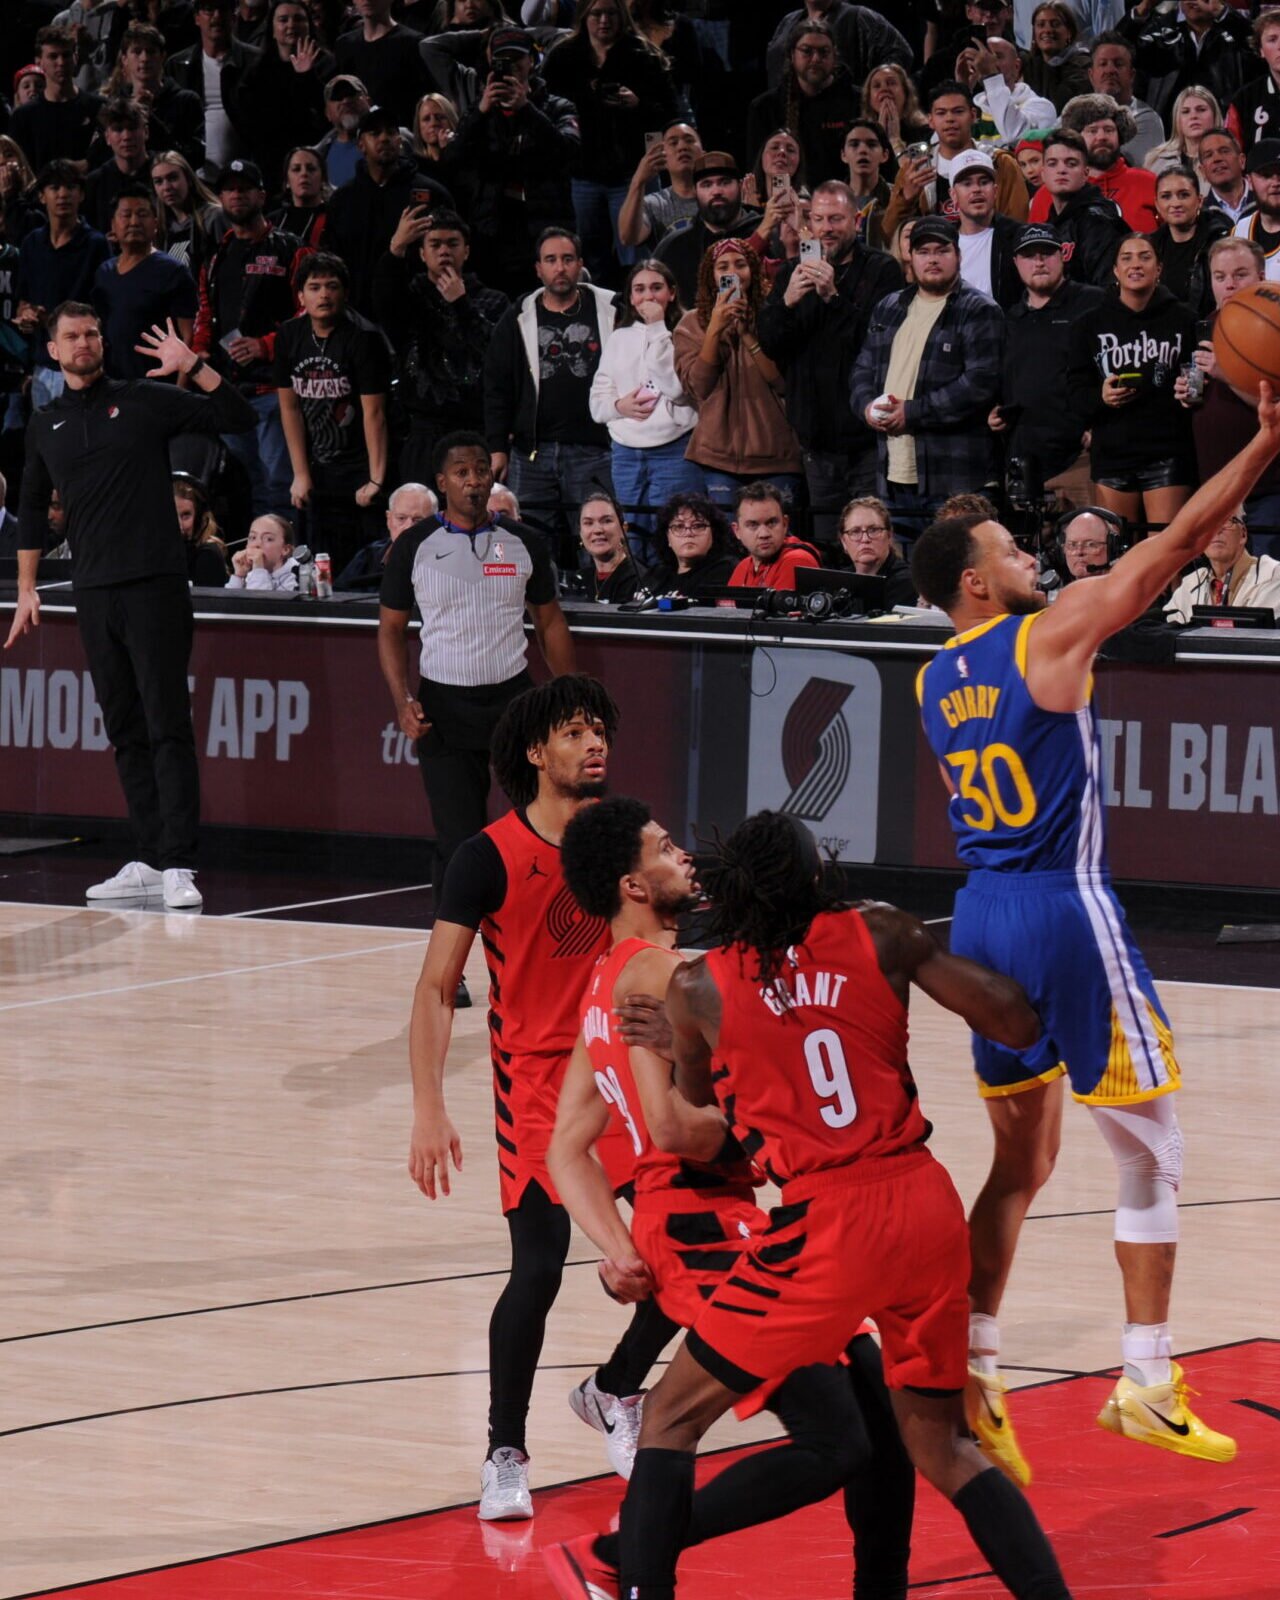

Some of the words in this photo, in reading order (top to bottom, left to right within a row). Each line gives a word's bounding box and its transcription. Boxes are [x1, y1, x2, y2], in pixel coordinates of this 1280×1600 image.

[1097, 330, 1183, 377] Portland
[483, 565, 516, 575] Emirates
[206, 677, 310, 761] APP
[939, 685, 1000, 728] CURRY
[944, 743, 1037, 831] 30
[759, 972, 848, 1016] GRANT
[803, 1028, 858, 1129] 9
